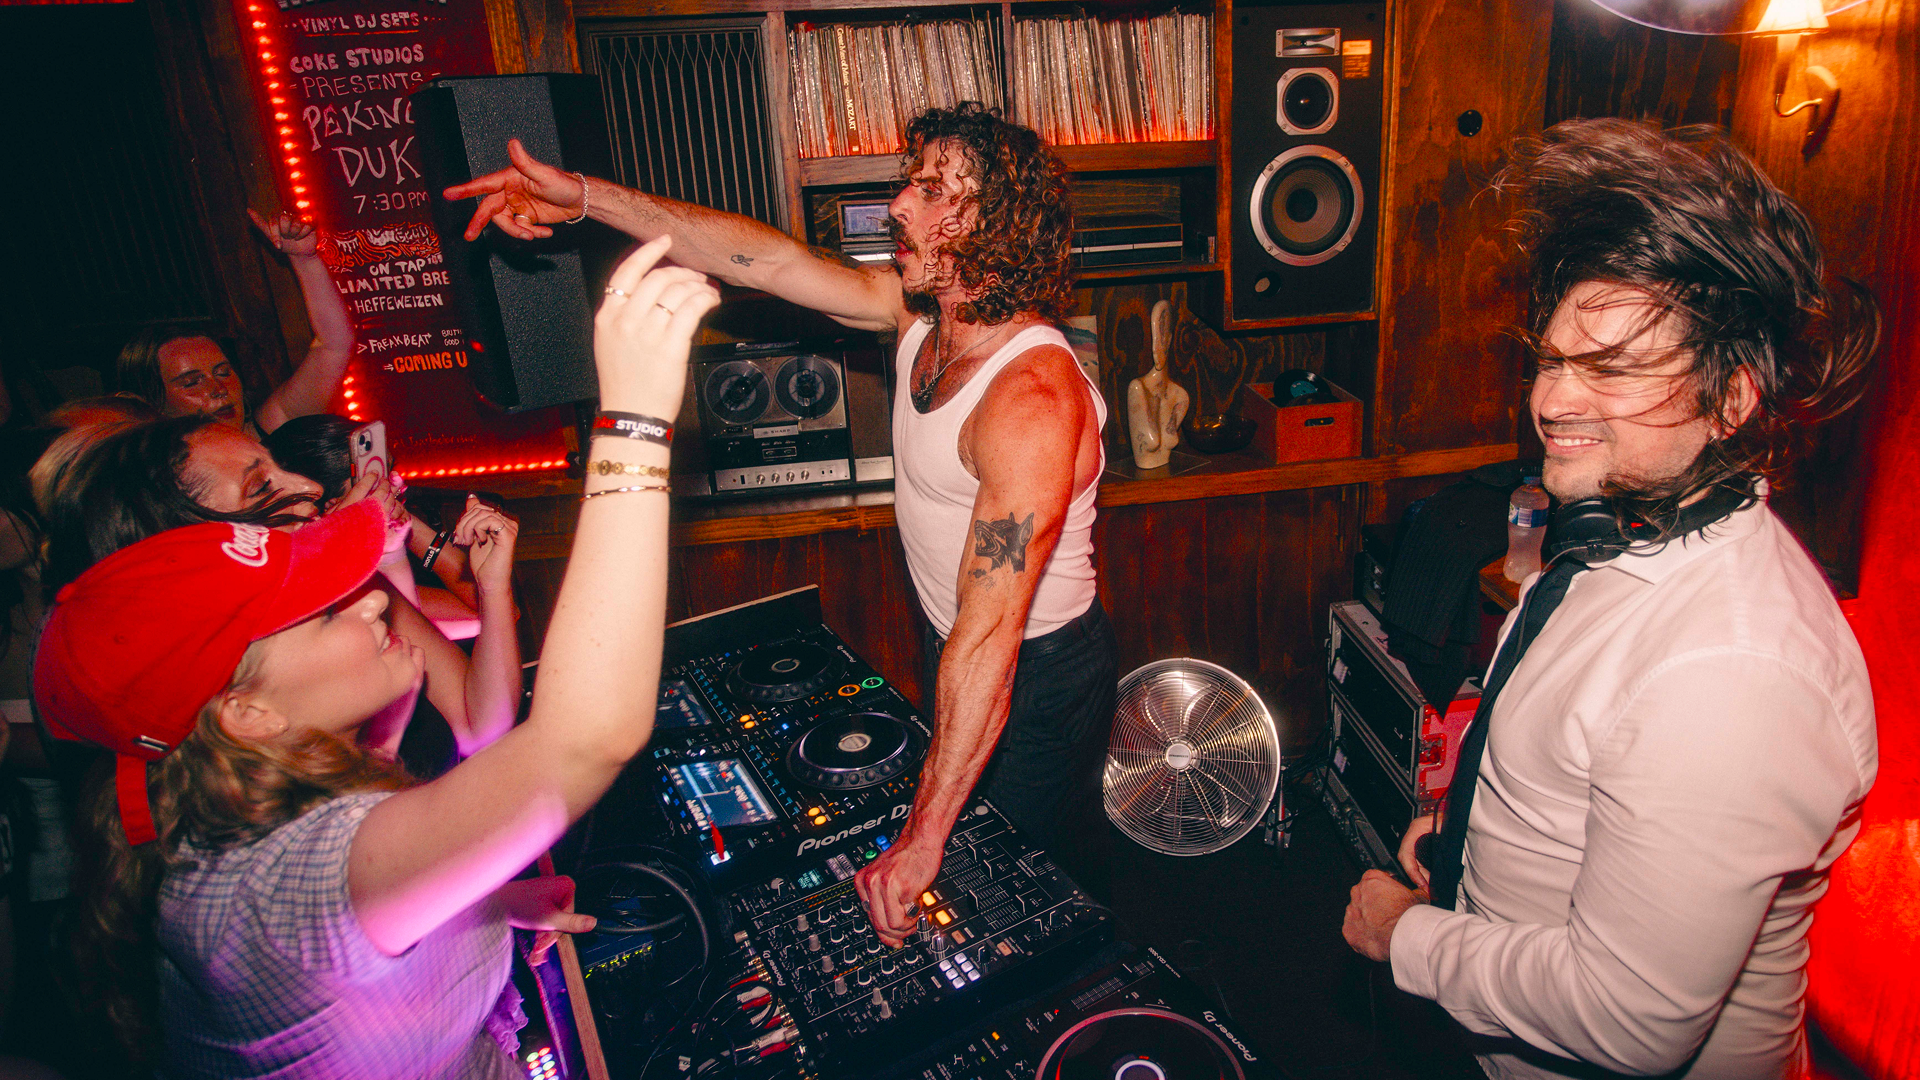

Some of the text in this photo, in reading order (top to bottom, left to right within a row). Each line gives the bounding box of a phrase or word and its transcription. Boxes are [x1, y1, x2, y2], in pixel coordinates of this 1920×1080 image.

[300, 11, 419, 33] VINYL DJ SETS
[290, 43, 424, 74] COKE STUDIOS
[302, 71, 424, 98] PRESENTS
[847, 99, 856, 131] MOZART
[369, 262, 390, 276] ON
[395, 258, 426, 273] TAP
[336, 270, 450, 294] LIMITED BRE
[355, 293, 444, 314] HEFFEWEIZEN
[393, 351, 453, 373] COMING
[616, 419, 665, 437] STUDIO
[797, 804, 914, 857] Pioneer DJ
[763, 950, 786, 986] Pioneer DJ
[1203, 1011, 1257, 1061] Pioneer DJ
